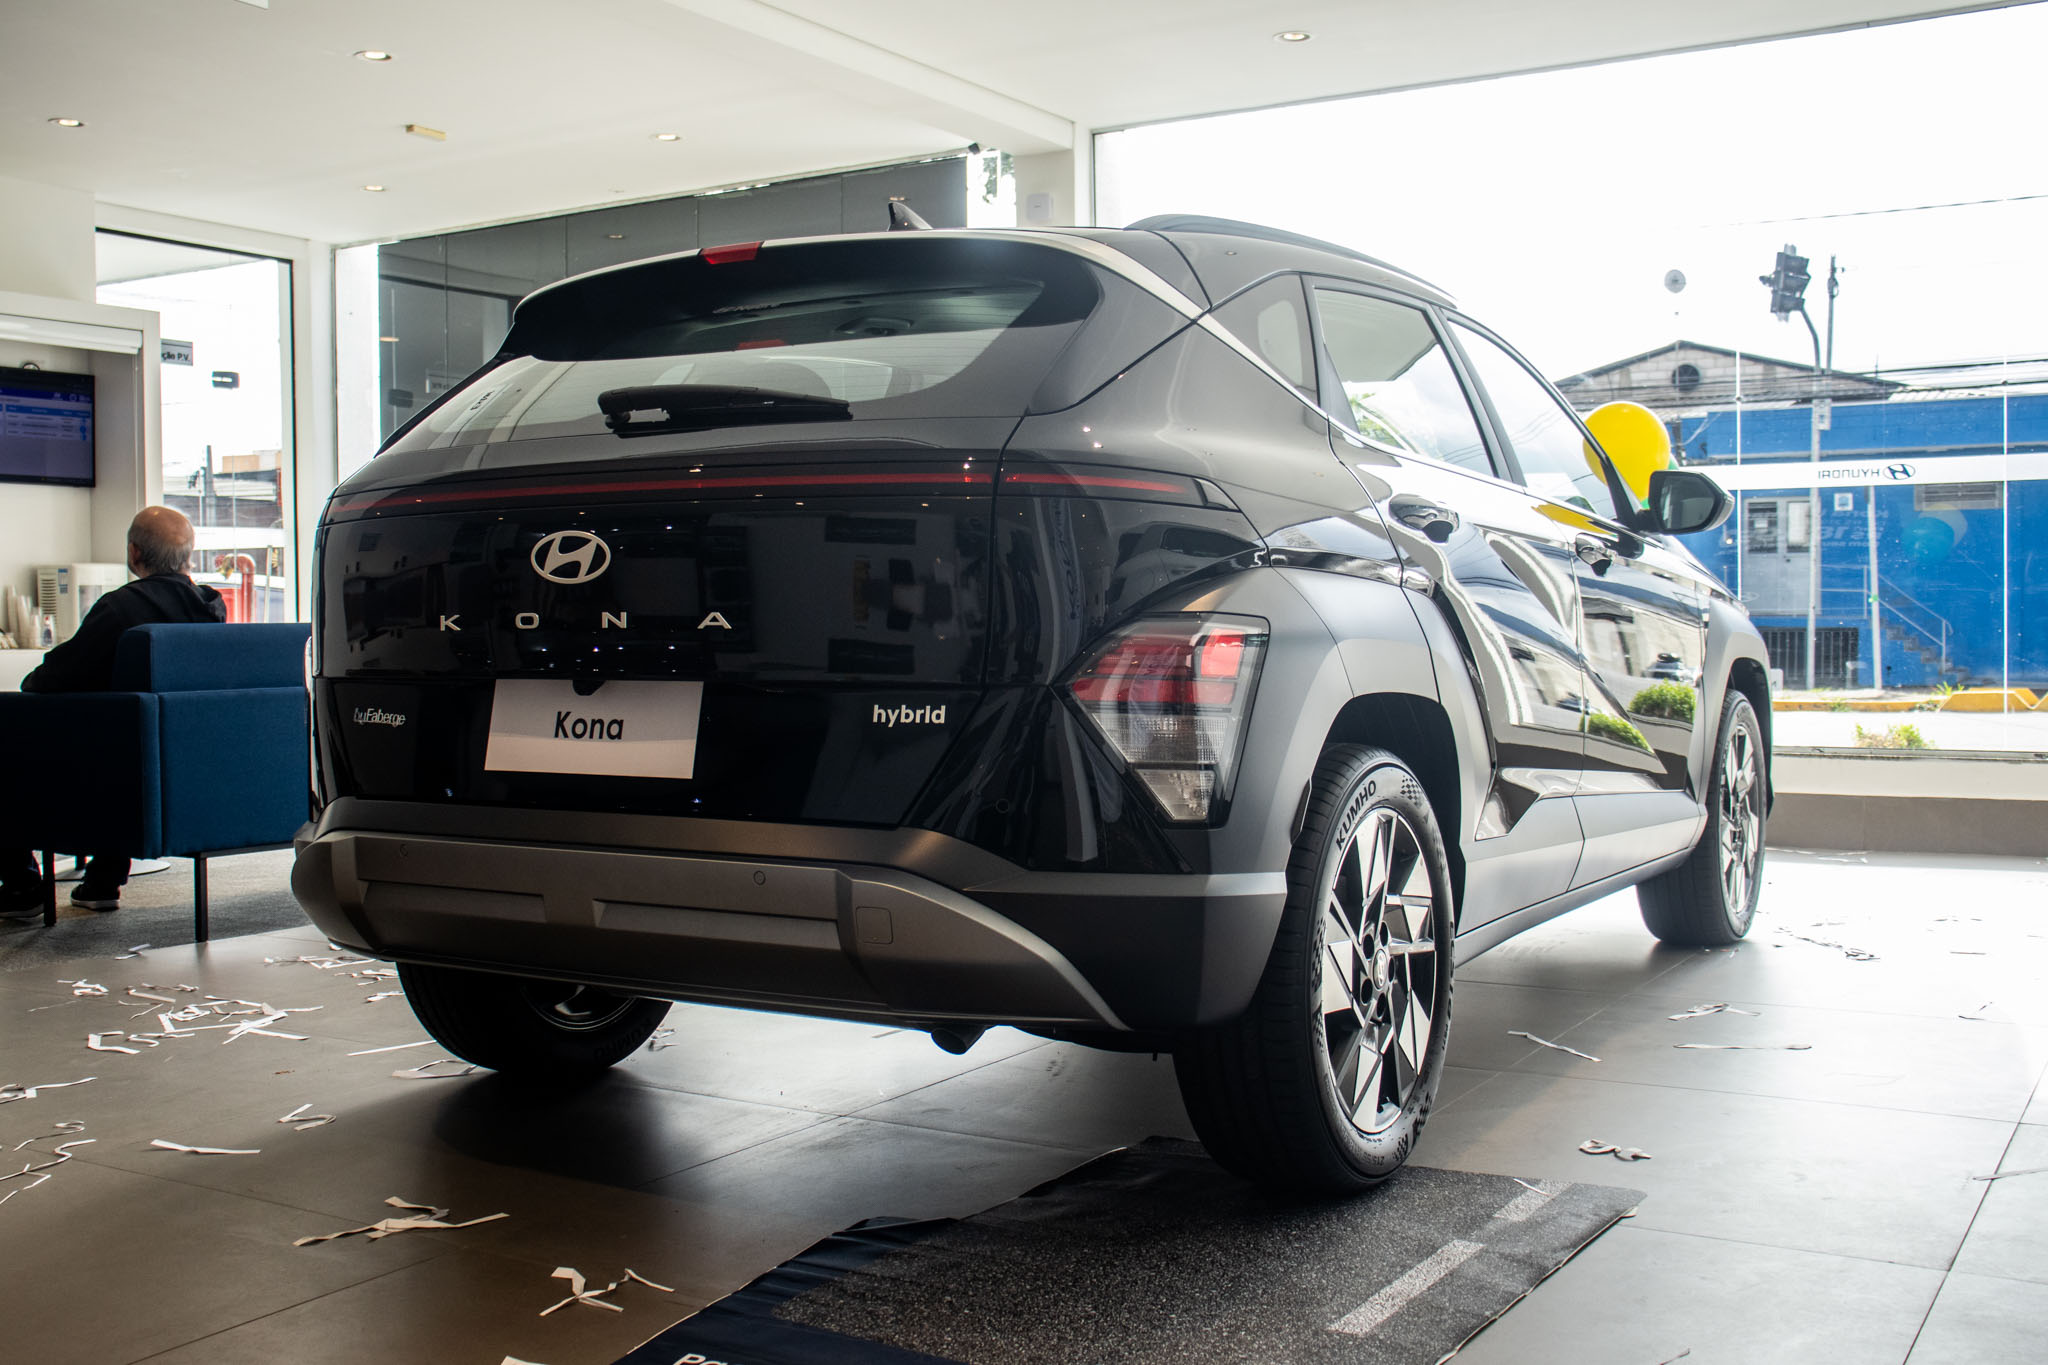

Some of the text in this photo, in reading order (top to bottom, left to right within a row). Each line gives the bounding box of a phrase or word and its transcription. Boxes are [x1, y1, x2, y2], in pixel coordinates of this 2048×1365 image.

[439, 611, 733, 632] KONA
[554, 711, 624, 740] Kona
[872, 704, 946, 728] hybrid
[1335, 780, 1376, 851] KUMHO
